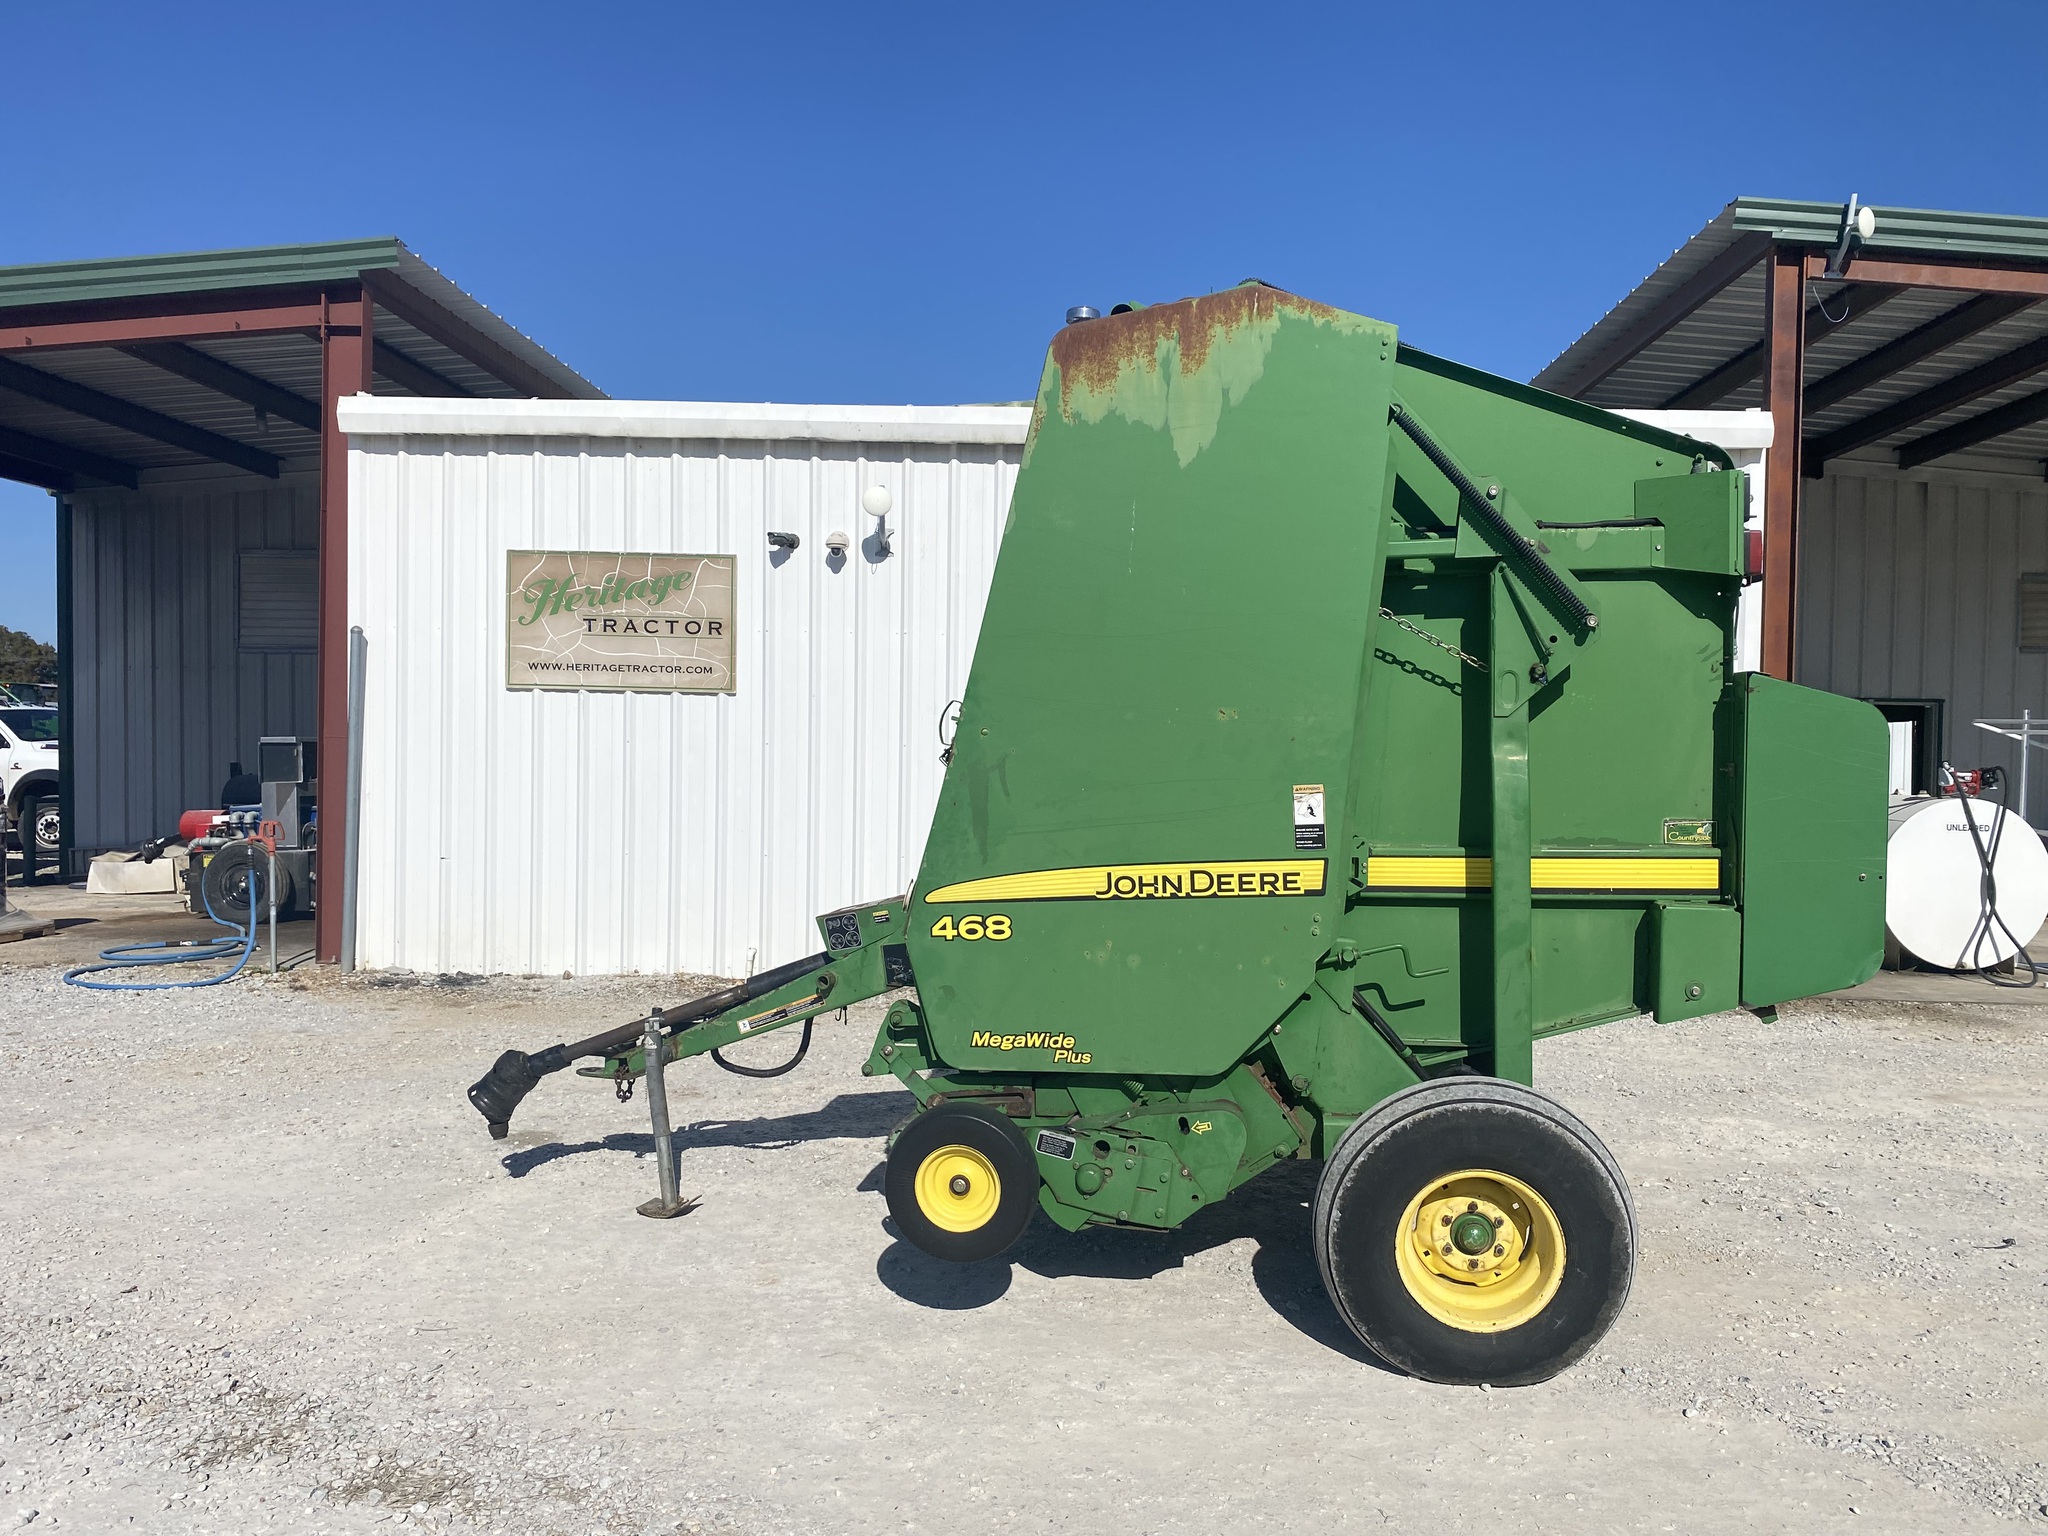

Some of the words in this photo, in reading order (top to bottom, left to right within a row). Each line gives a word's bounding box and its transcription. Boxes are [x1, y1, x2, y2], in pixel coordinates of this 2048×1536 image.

[517, 571, 696, 626] Heritage
[583, 618, 723, 636] TRACTOR
[528, 662, 713, 675] WWW.HERITAGETRACTOR.COM
[1095, 872, 1183, 895] JOHN
[1189, 869, 1302, 894] DEERE
[931, 914, 1012, 941] 468
[970, 1031, 1075, 1050] MegaWide
[1053, 1049, 1092, 1064] Plus
